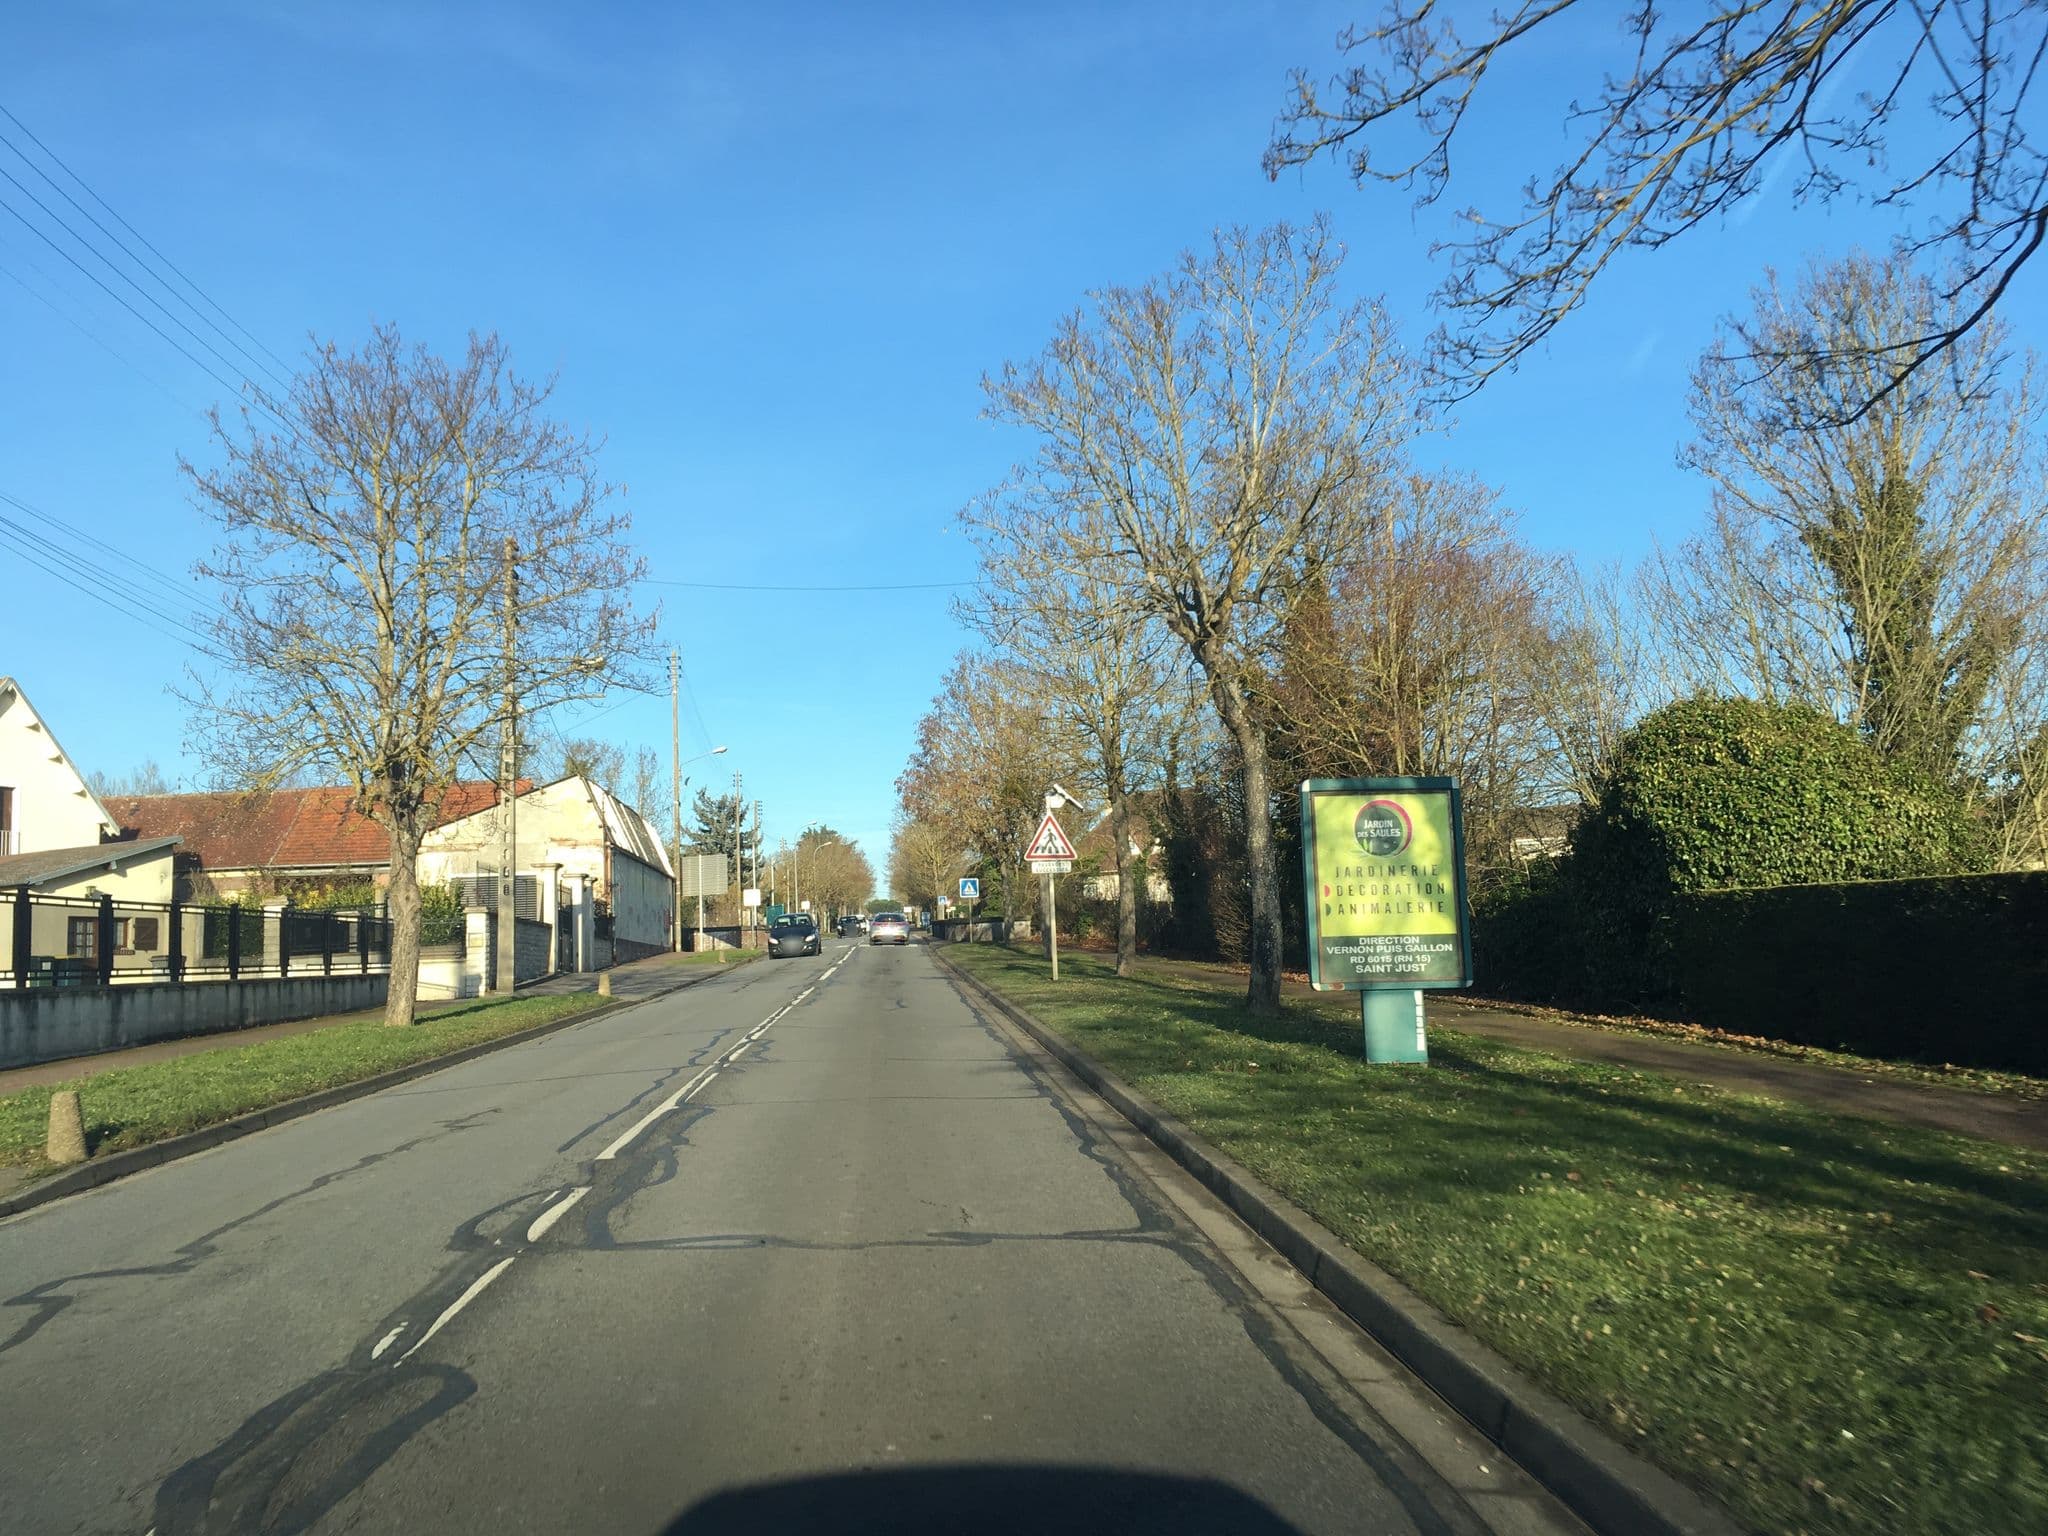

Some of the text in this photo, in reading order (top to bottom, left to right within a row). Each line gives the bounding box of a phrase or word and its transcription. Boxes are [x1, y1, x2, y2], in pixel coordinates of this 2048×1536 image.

[1363, 819, 1393, 829] JARDIN
[1370, 828, 1401, 838] SAULES
[1336, 864, 1438, 878] JARDINERIE
[1338, 901, 1445, 915] ANIMALERIE
[1359, 935, 1420, 945] DIRECTION
[1326, 943, 1453, 955] VERNON PUIS GAILLON
[1350, 954, 1431, 964] RD 6015 (RN 15)
[1355, 963, 1428, 973] SAINT JUST
